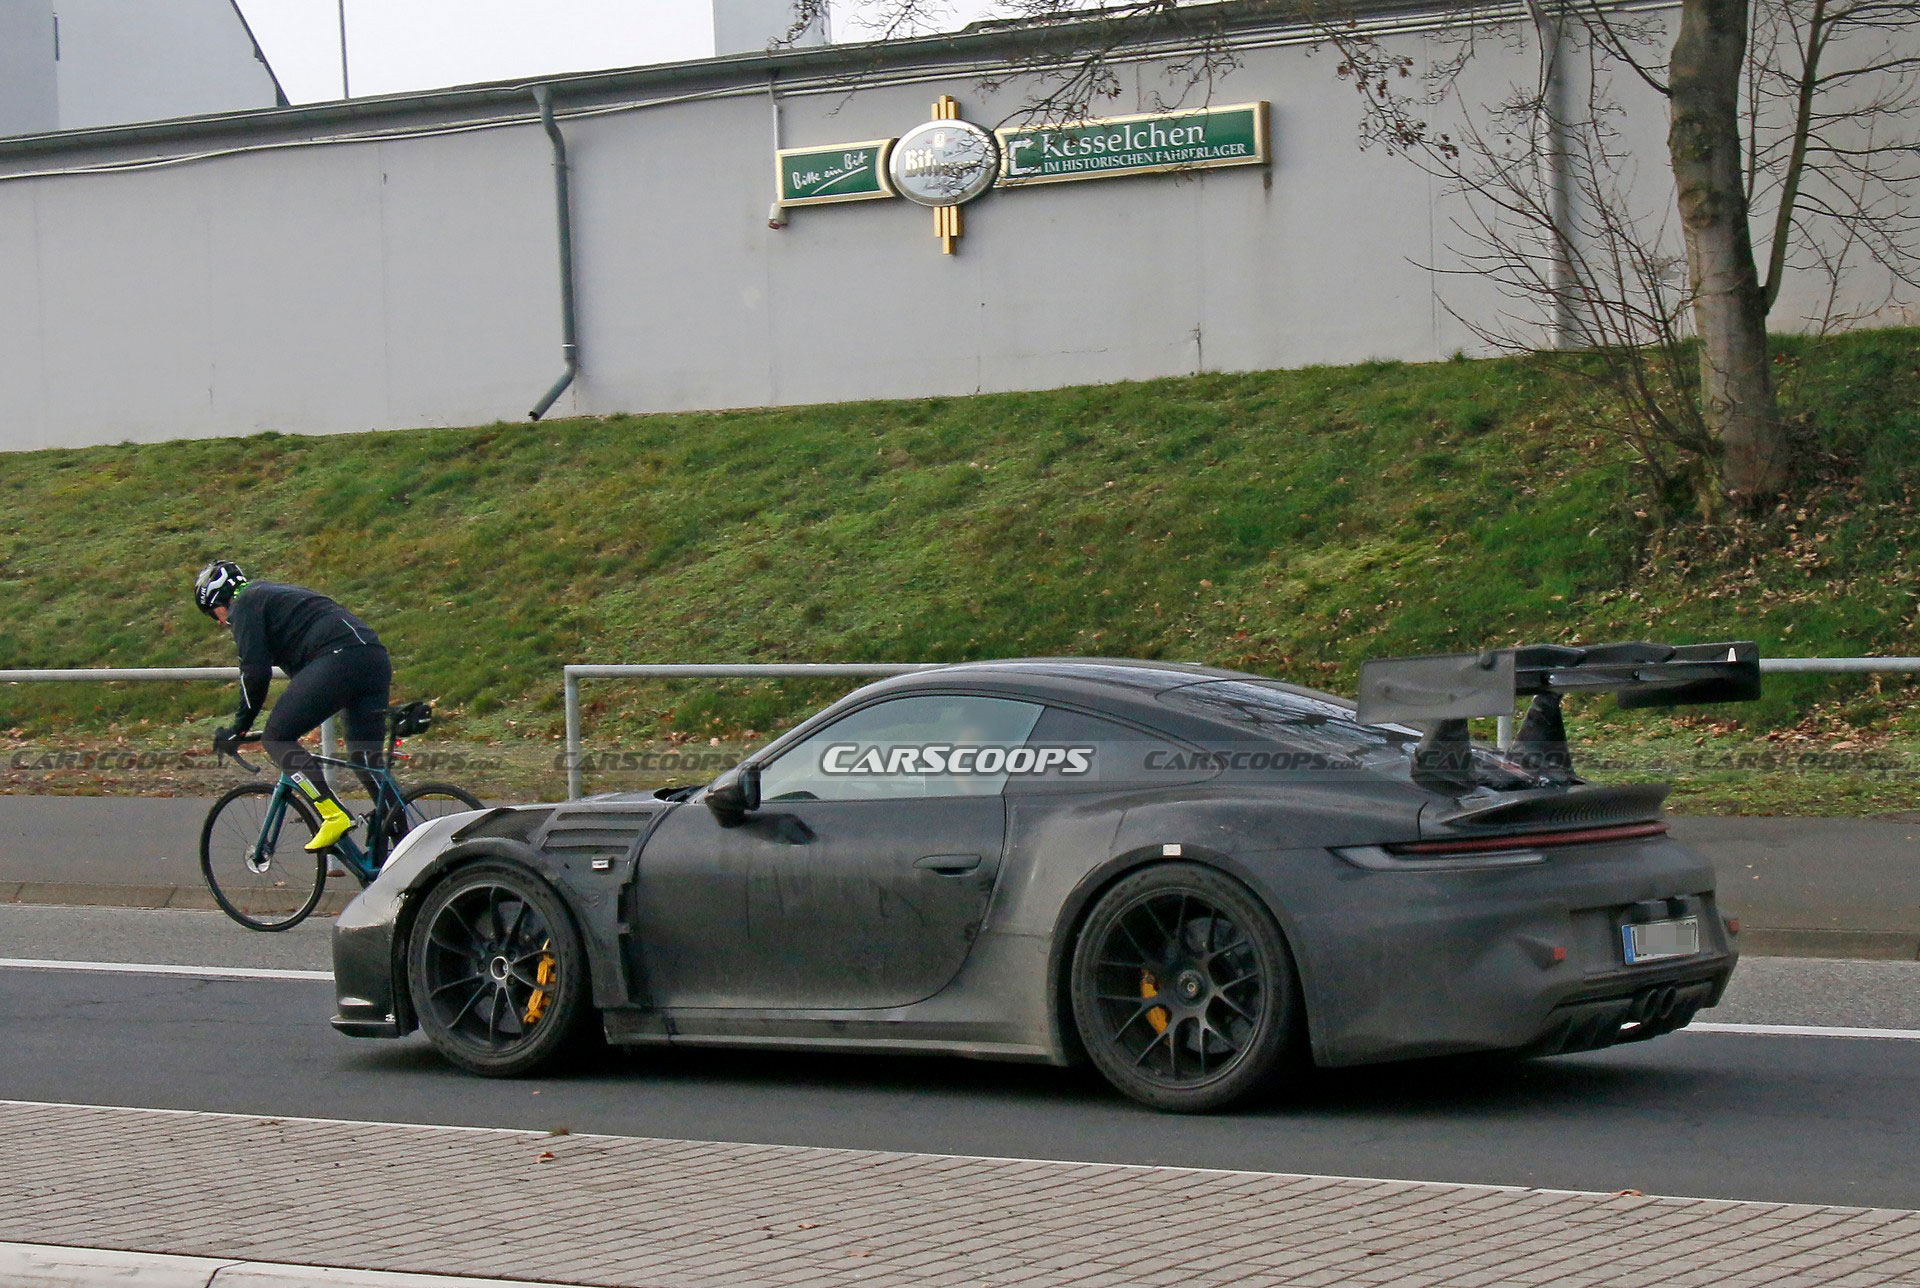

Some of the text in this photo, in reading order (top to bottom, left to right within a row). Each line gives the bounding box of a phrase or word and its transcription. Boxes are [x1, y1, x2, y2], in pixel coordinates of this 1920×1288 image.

[1041, 123, 1206, 158] Kesselchen
[1044, 143, 1247, 173] IM HISTORISCHEN FAHRERLAGER
[792, 151, 868, 189] Bitte ein Bit
